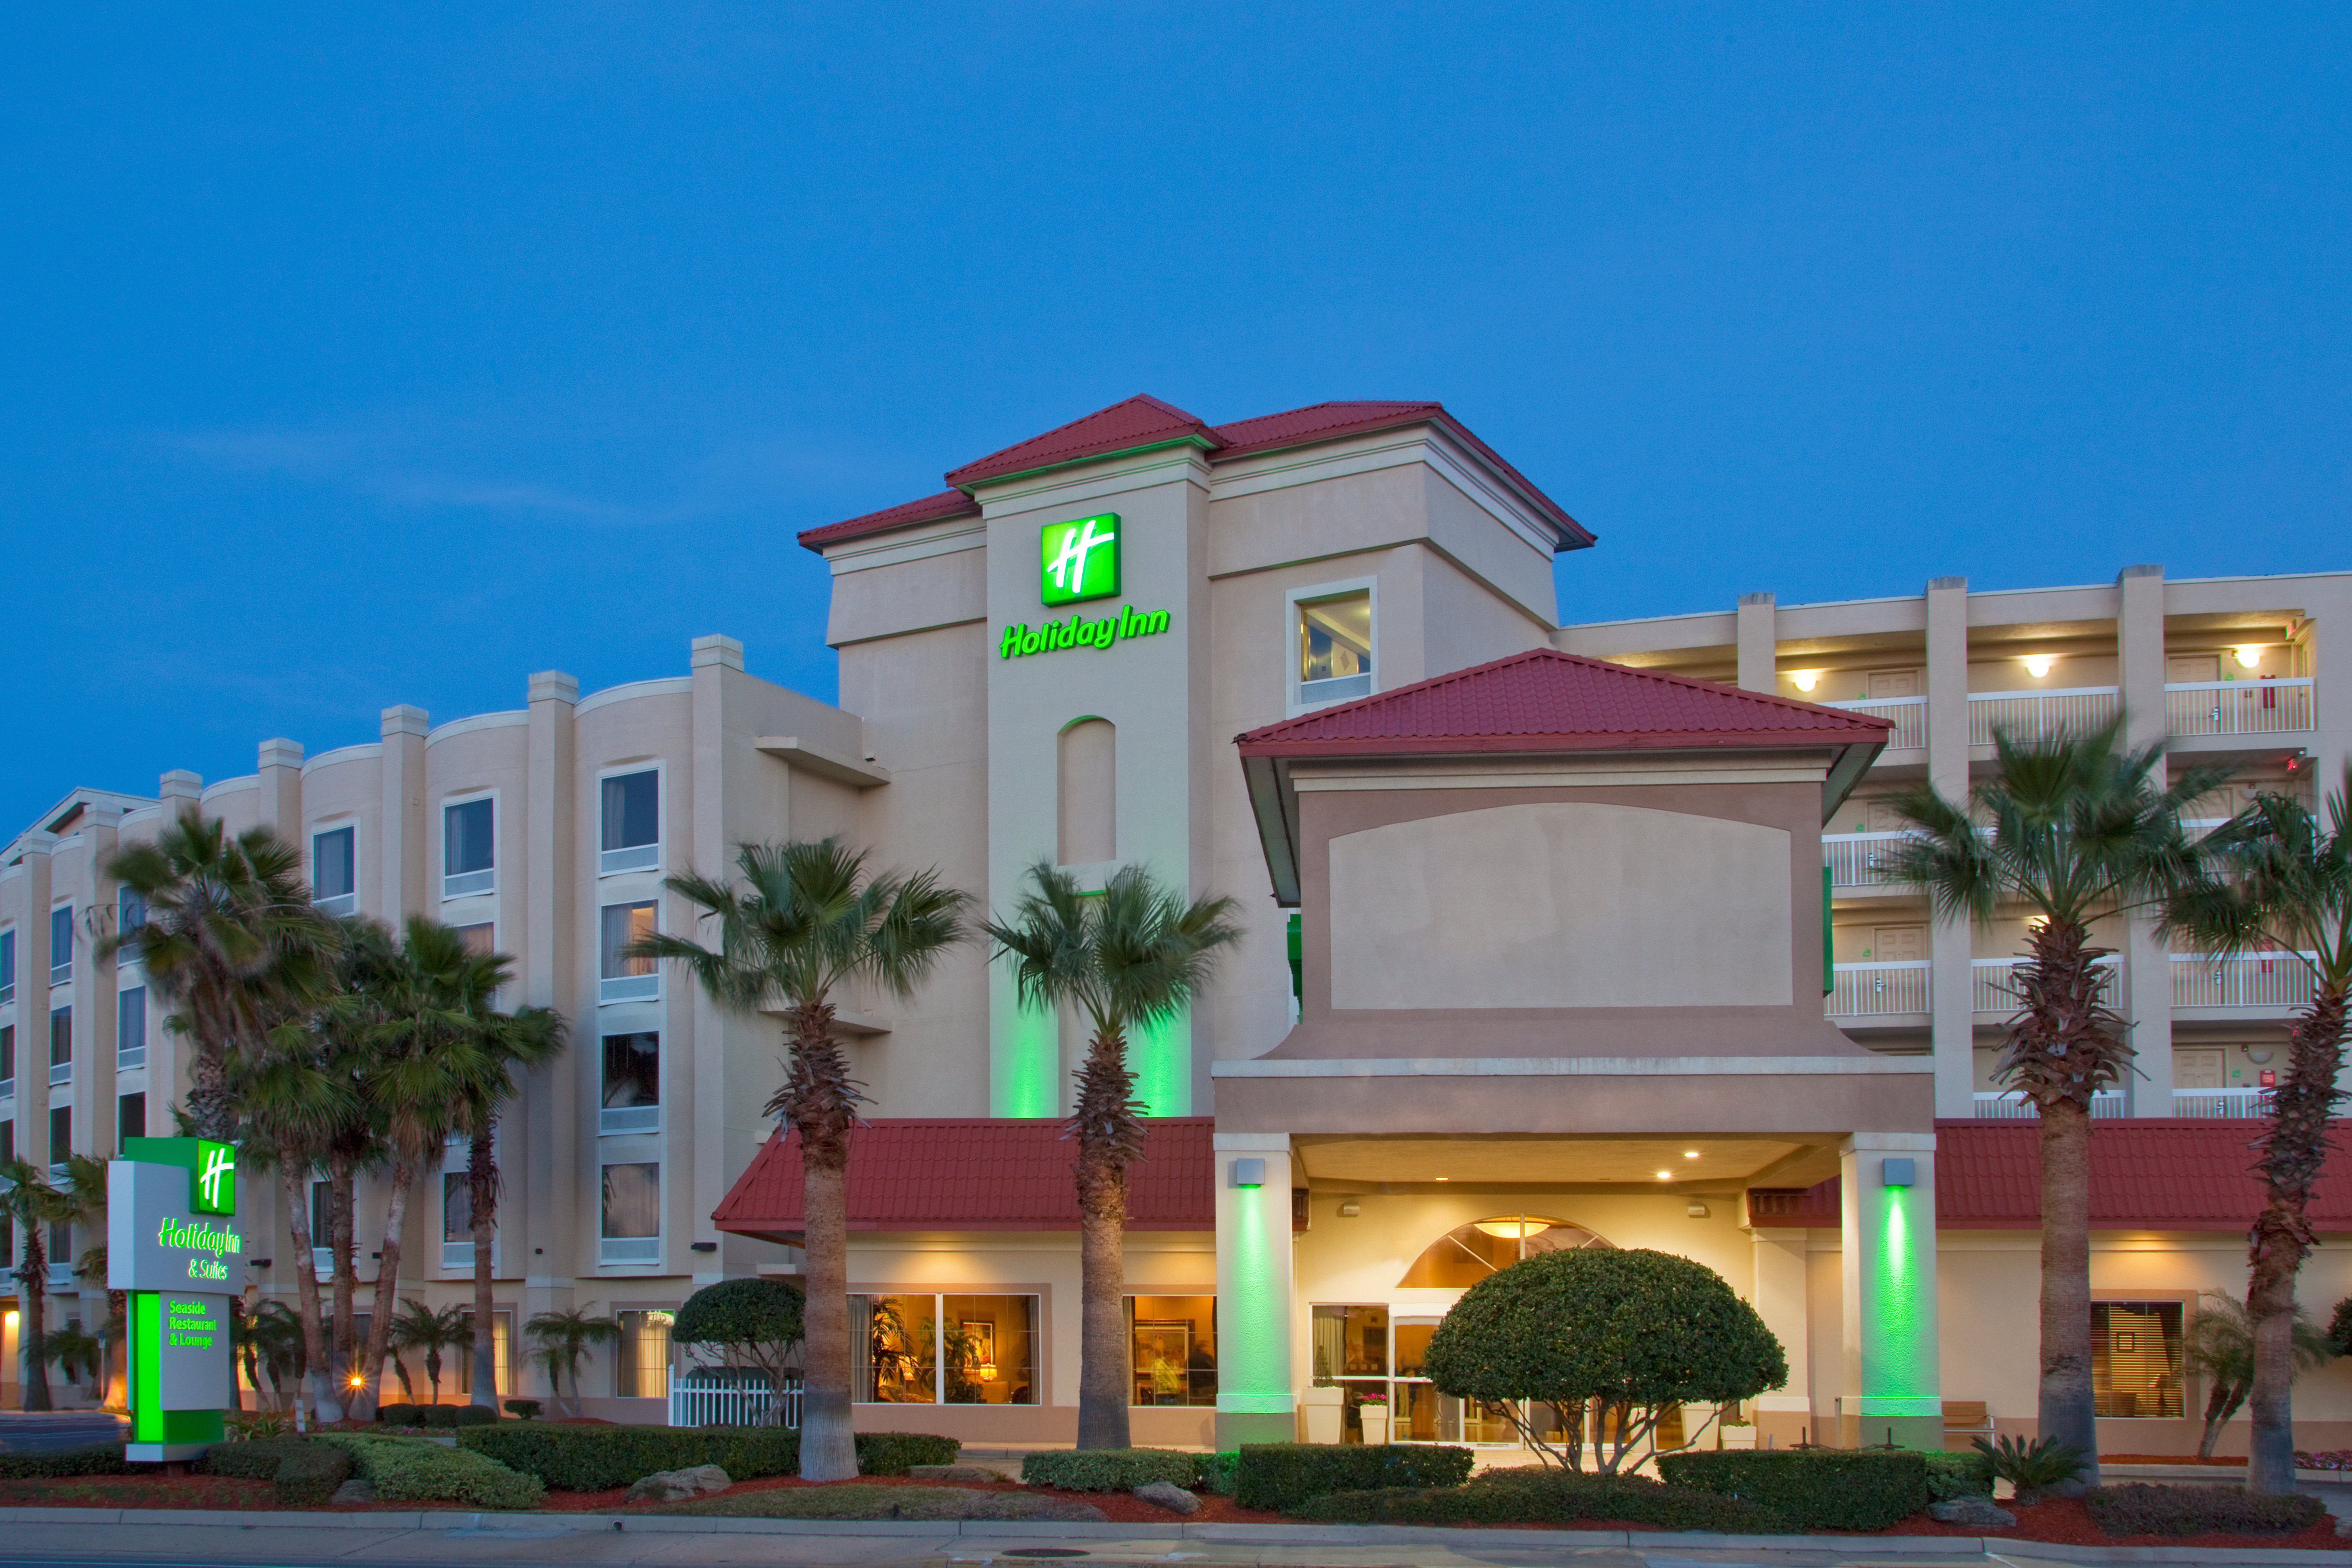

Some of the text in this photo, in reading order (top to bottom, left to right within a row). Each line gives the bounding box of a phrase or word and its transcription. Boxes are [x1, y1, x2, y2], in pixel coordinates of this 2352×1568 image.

[1000, 604, 1171, 659] Holiday Inn
[158, 1217, 241, 1258] Holiday Inn
[188, 1258, 228, 1279] & Suites
[169, 1299, 206, 1315] Seaside
[169, 1316, 217, 1331] Restaurant
[169, 1332, 212, 1350] & Lounge
